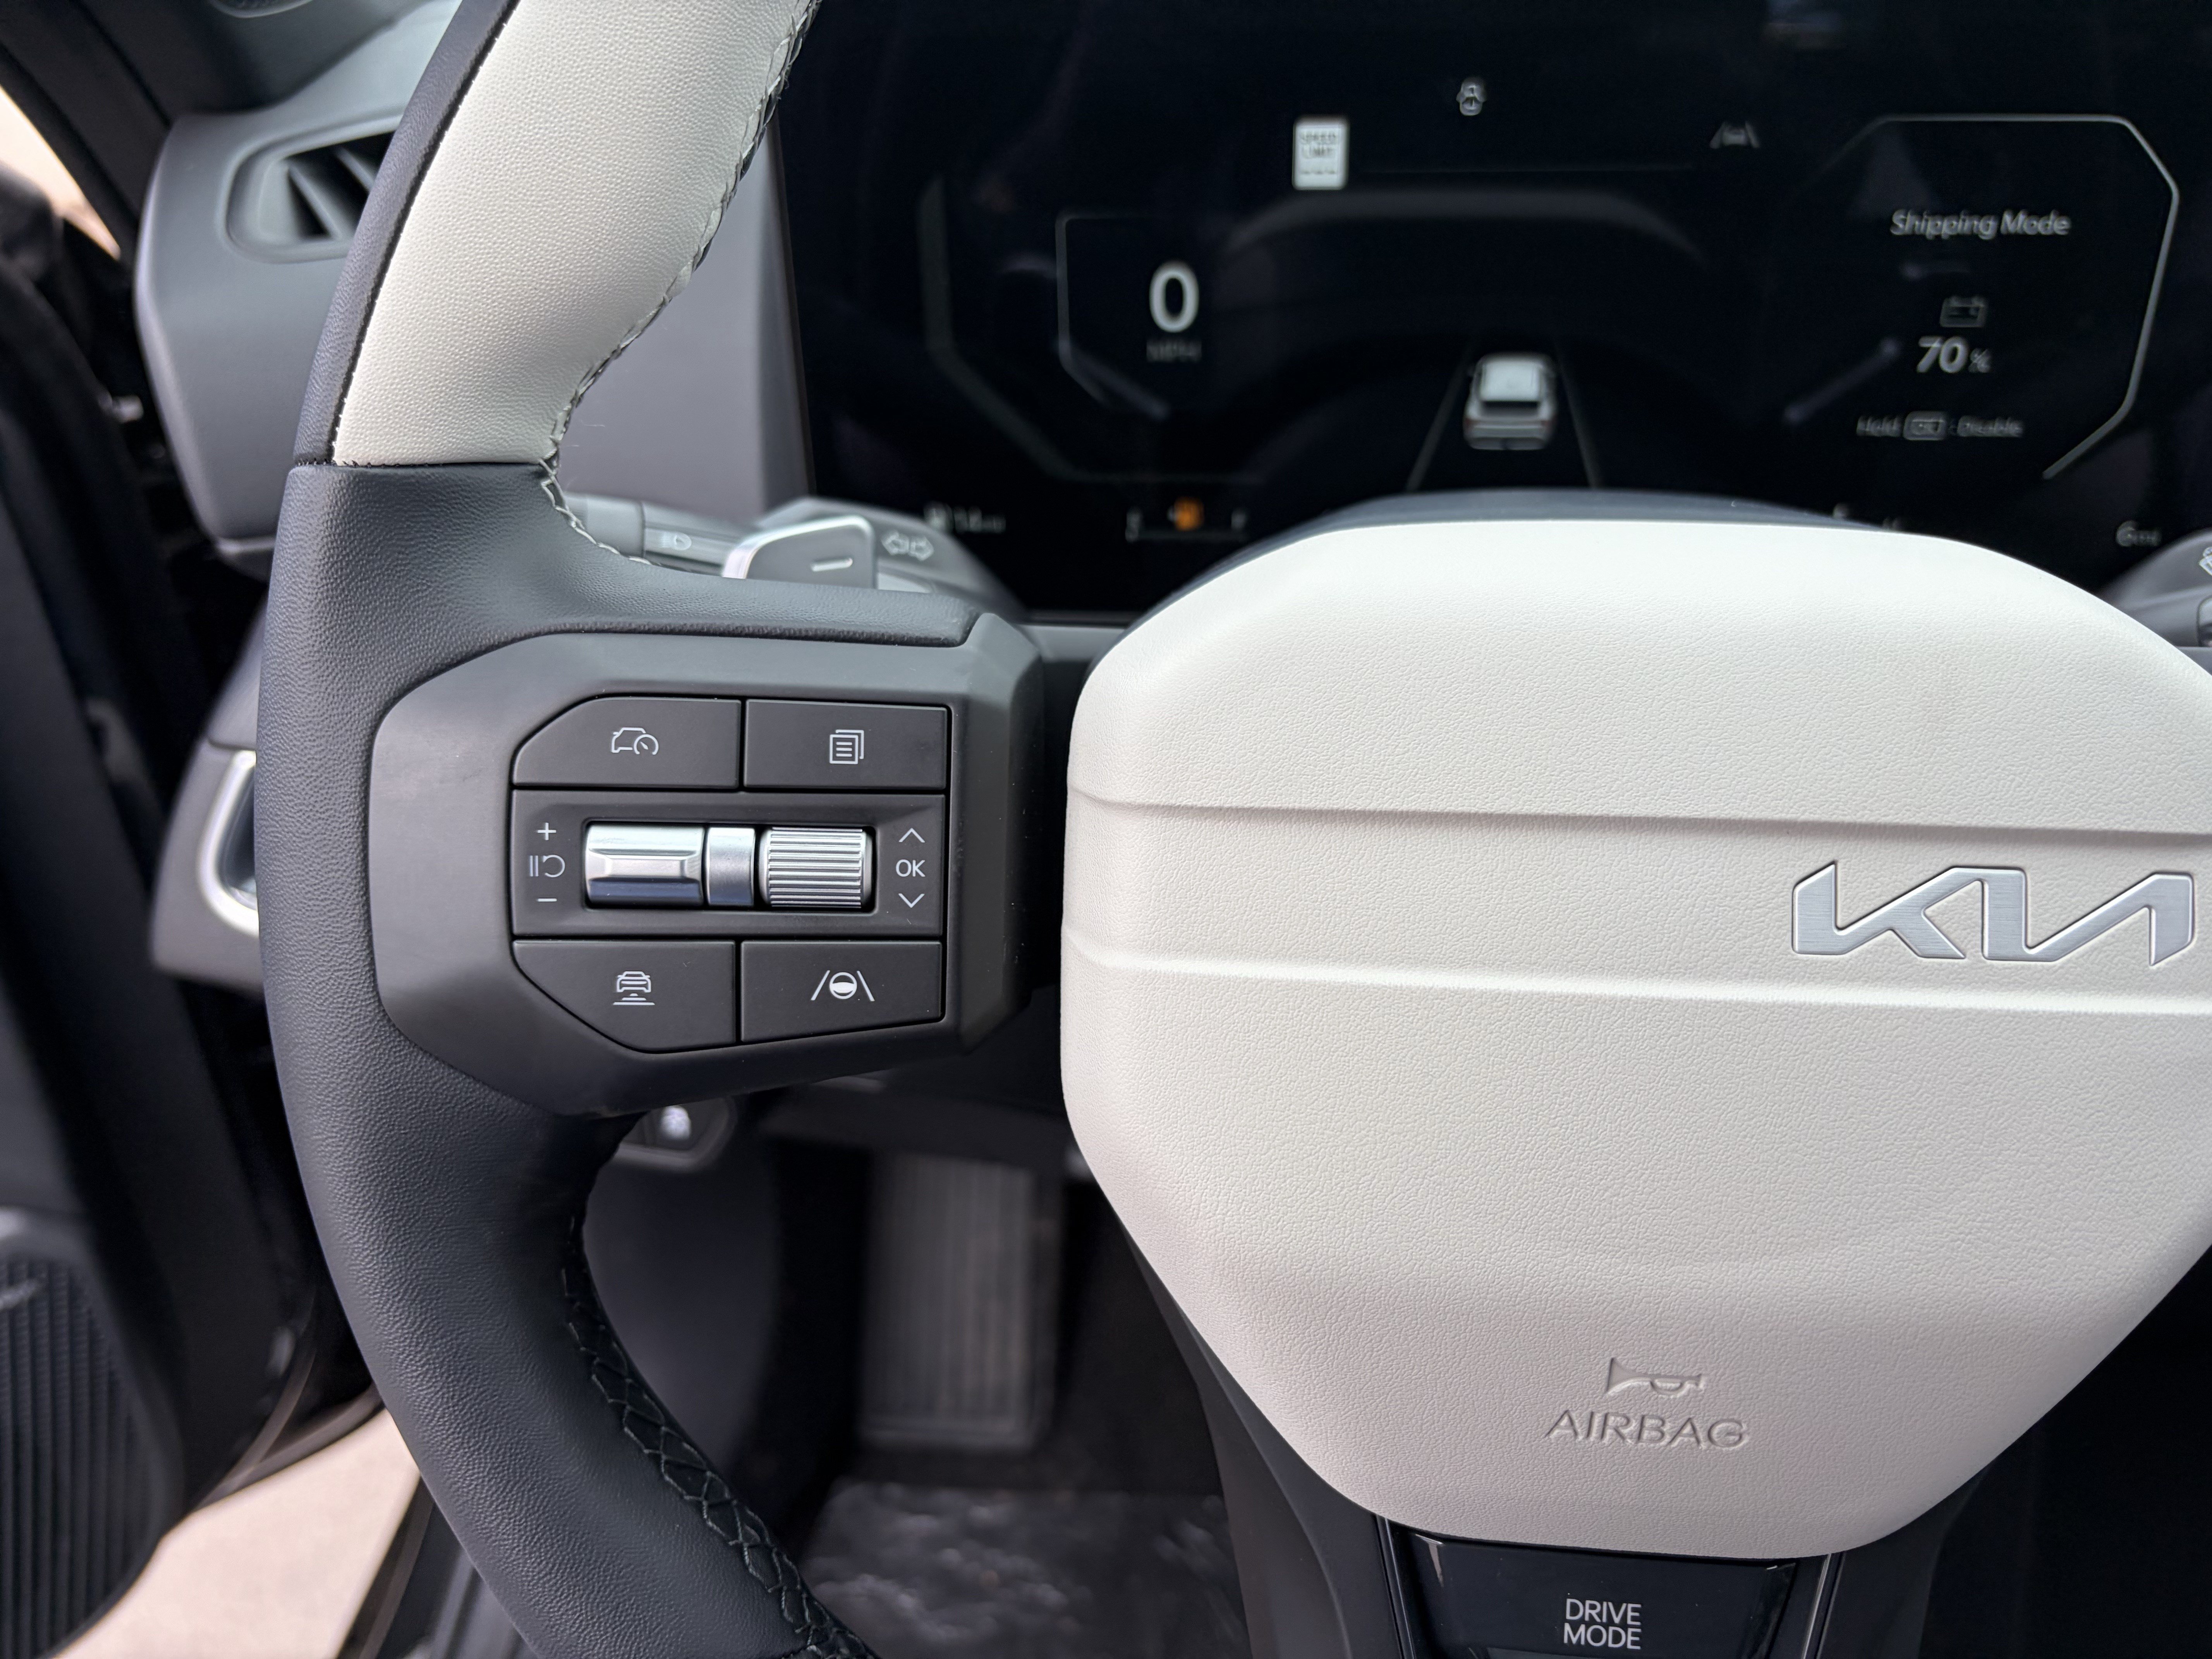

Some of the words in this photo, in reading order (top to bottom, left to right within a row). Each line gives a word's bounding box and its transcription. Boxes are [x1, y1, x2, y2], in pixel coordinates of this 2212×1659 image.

[1890, 210, 1998, 240] Shipping
[2001, 211, 2070, 235] Mode
[1149, 263, 1199, 332] 0
[896, 859, 926, 877] OK
[1545, 1410, 1748, 1449] AIRBAG
[1566, 1598, 1642, 1626] DRIVE
[1564, 1623, 1642, 1650] MODE
